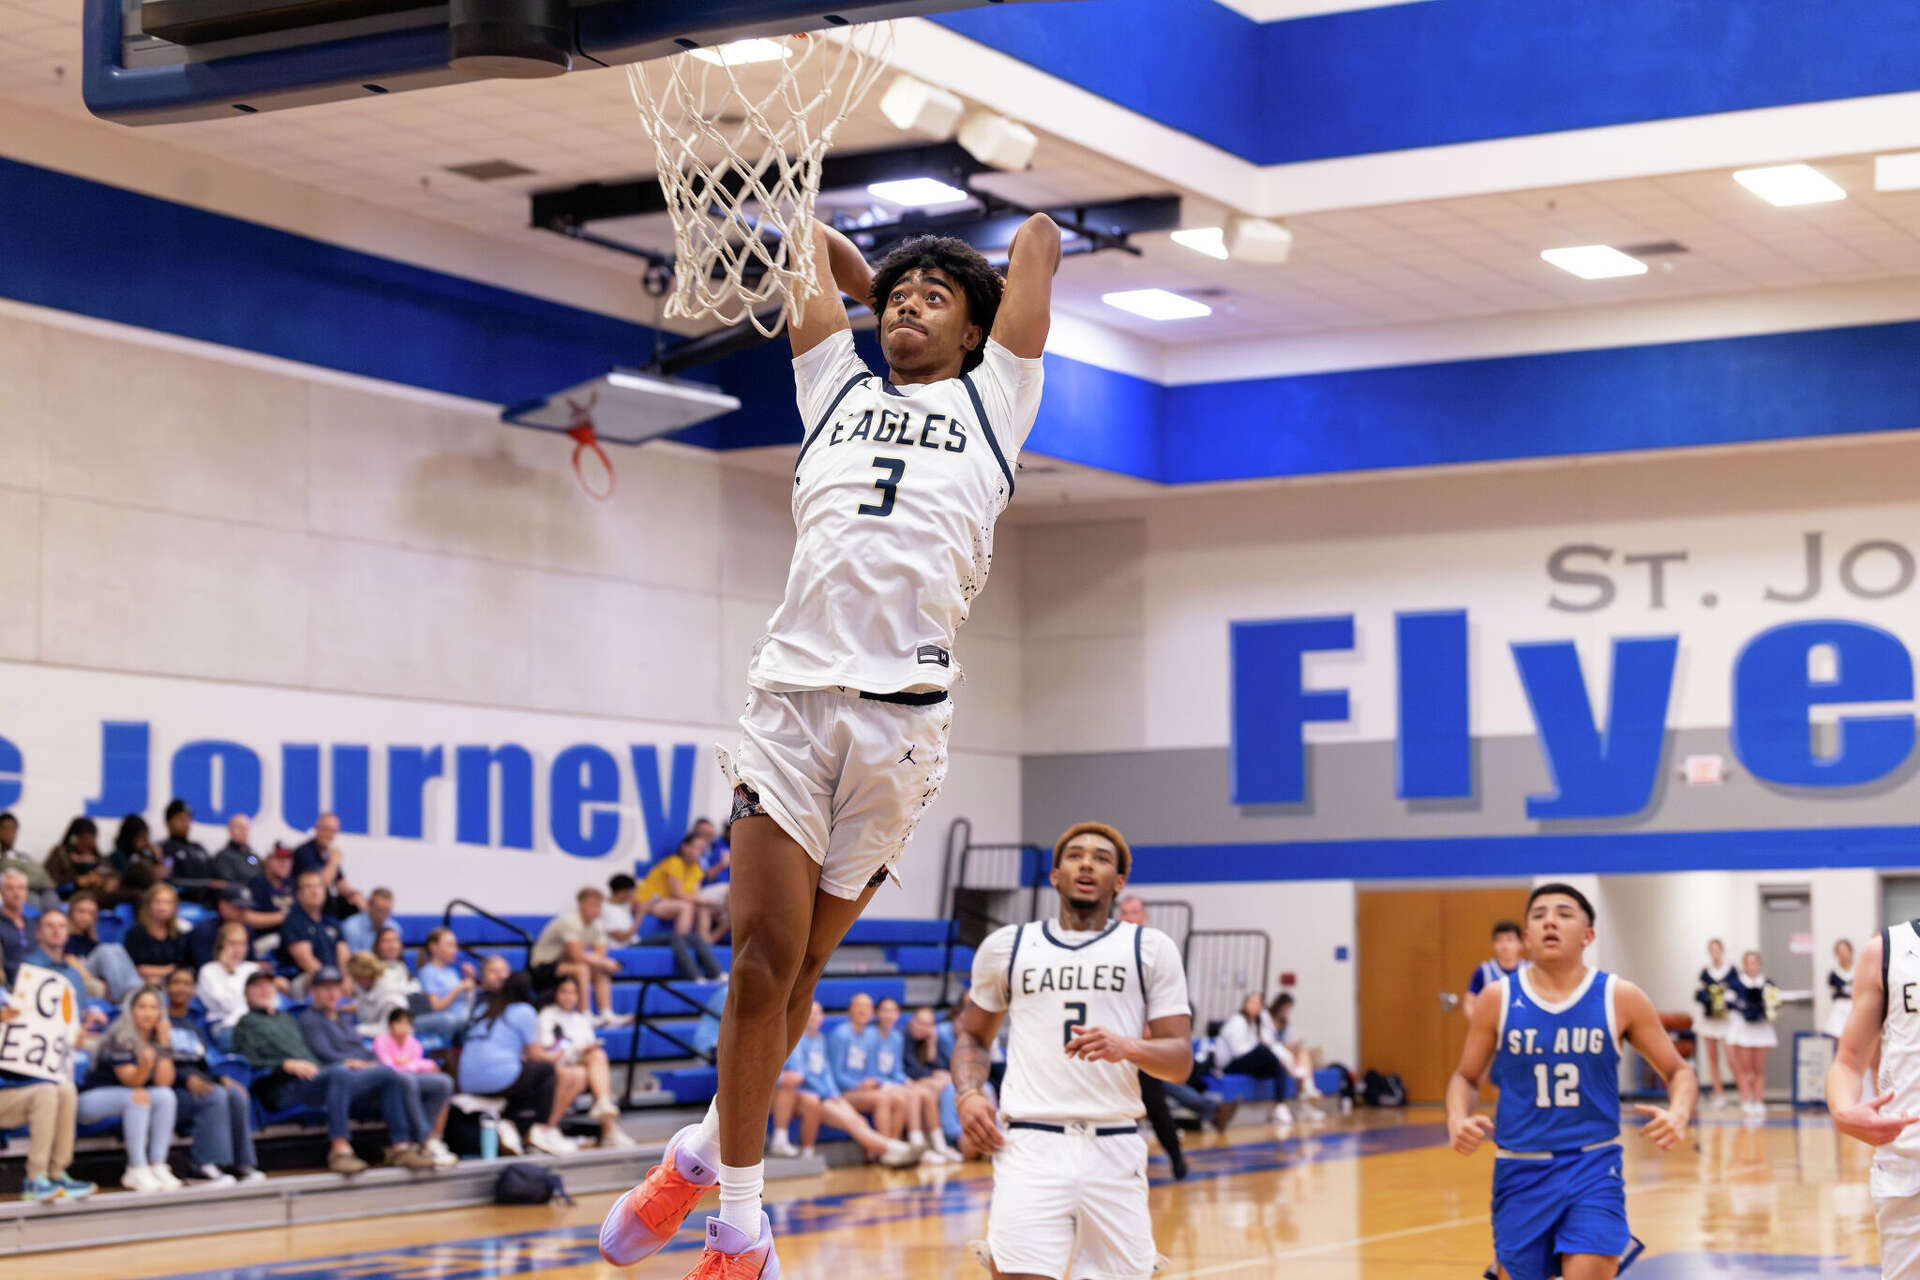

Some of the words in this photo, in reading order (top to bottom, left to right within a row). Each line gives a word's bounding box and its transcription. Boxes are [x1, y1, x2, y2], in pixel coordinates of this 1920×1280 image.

[829, 408, 967, 453] EAGLES
[857, 456, 906, 517] 3
[84, 720, 698, 880] Journey
[1022, 965, 1127, 995] EAGLES
[1064, 1002, 1087, 1050] 2
[1507, 1027, 1544, 1055] ST.
[1553, 1026, 1605, 1055] AUG
[1533, 1062, 1580, 1109] 12
